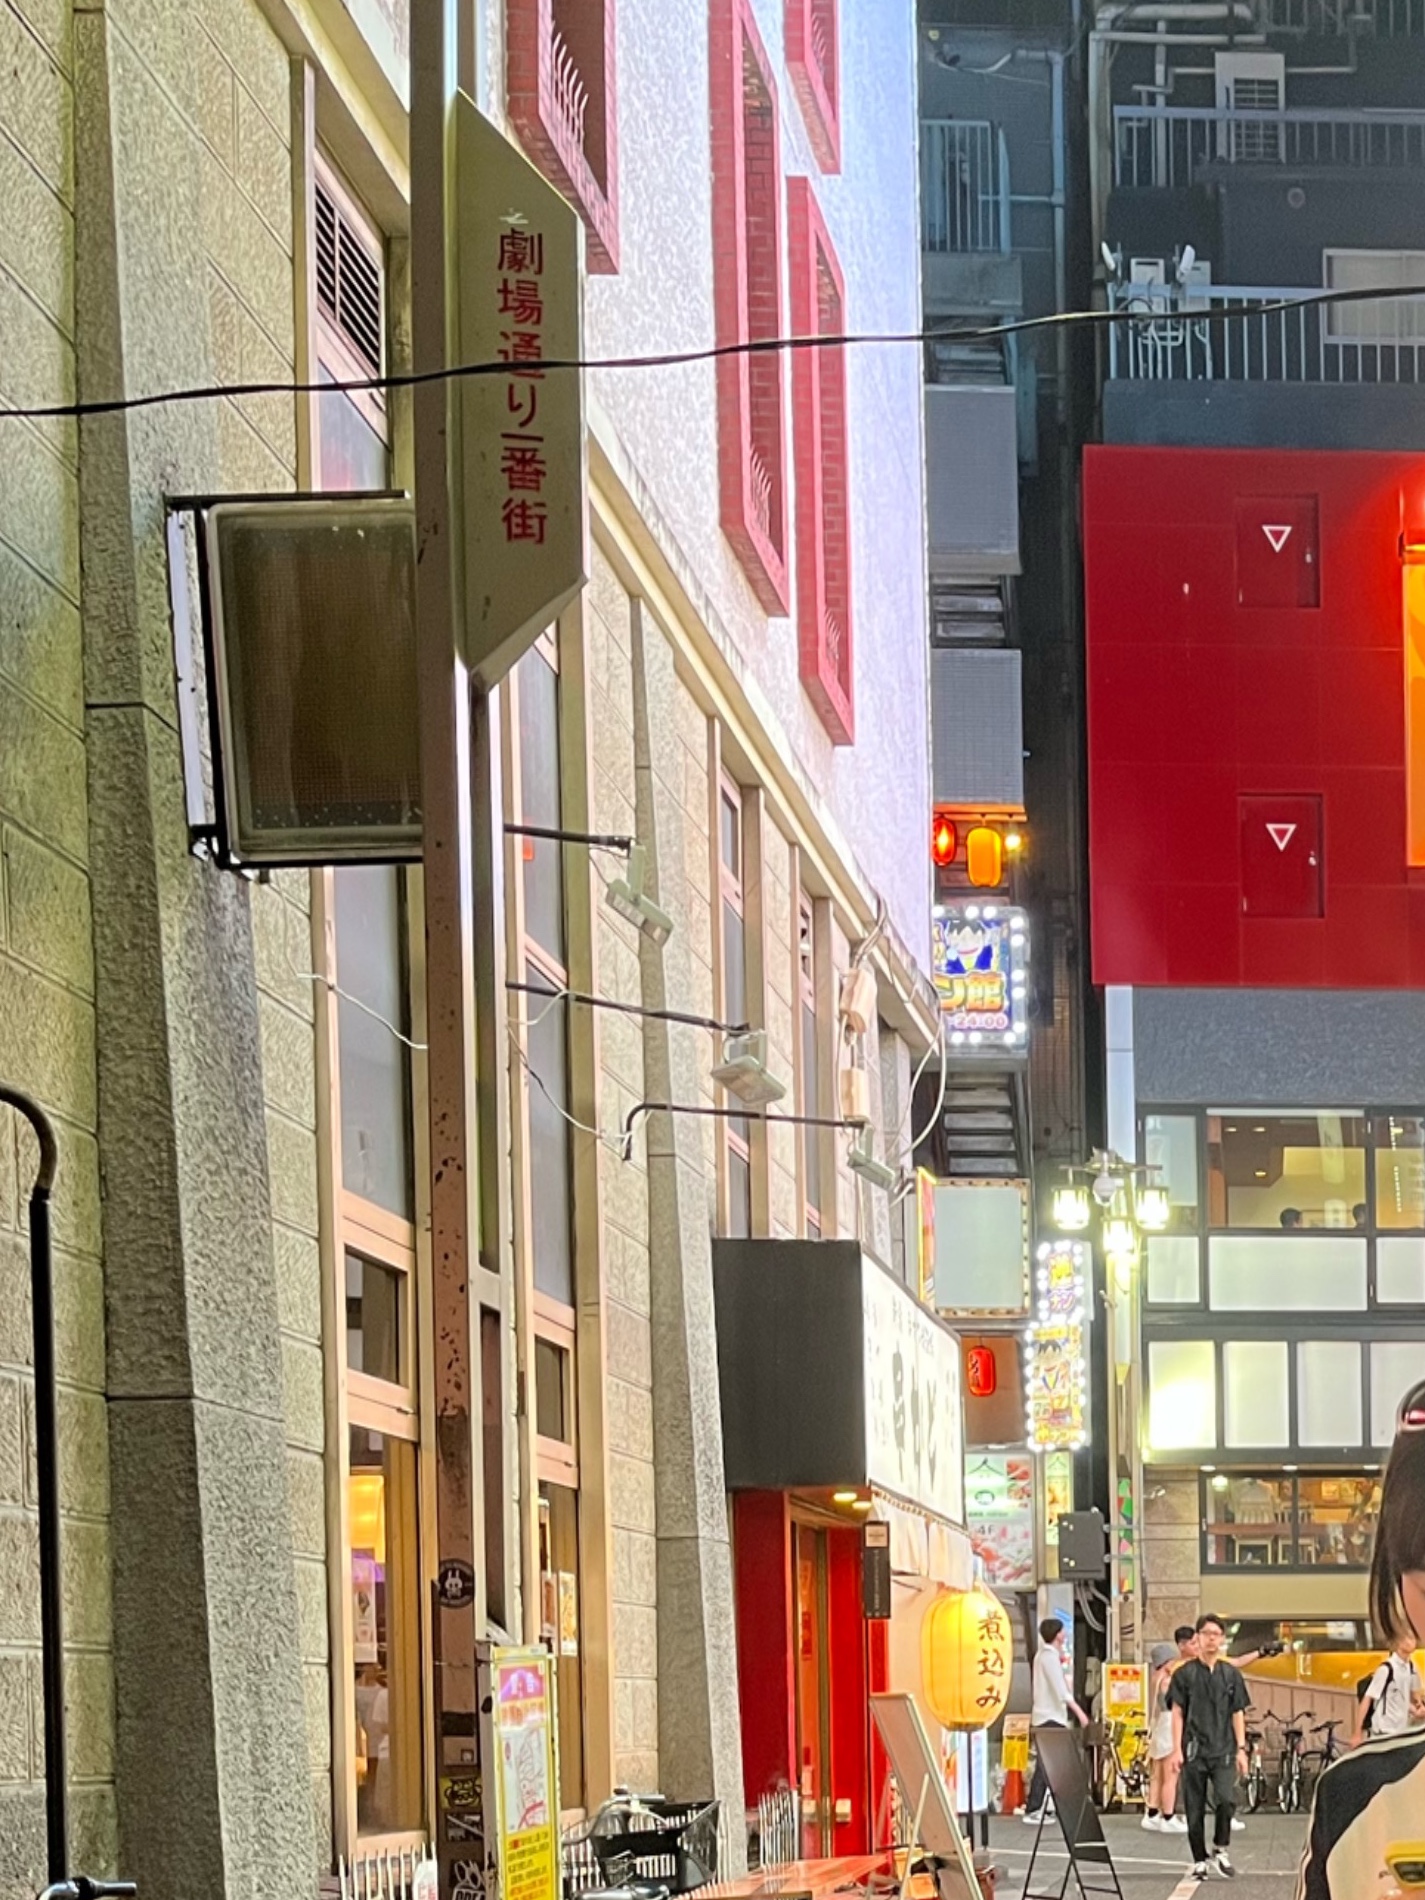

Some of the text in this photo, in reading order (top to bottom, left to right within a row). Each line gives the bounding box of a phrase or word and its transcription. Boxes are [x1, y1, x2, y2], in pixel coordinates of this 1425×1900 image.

[496, 228, 548, 546] 劇場通り一番街
[975, 1610, 1005, 1708] 煮込み
